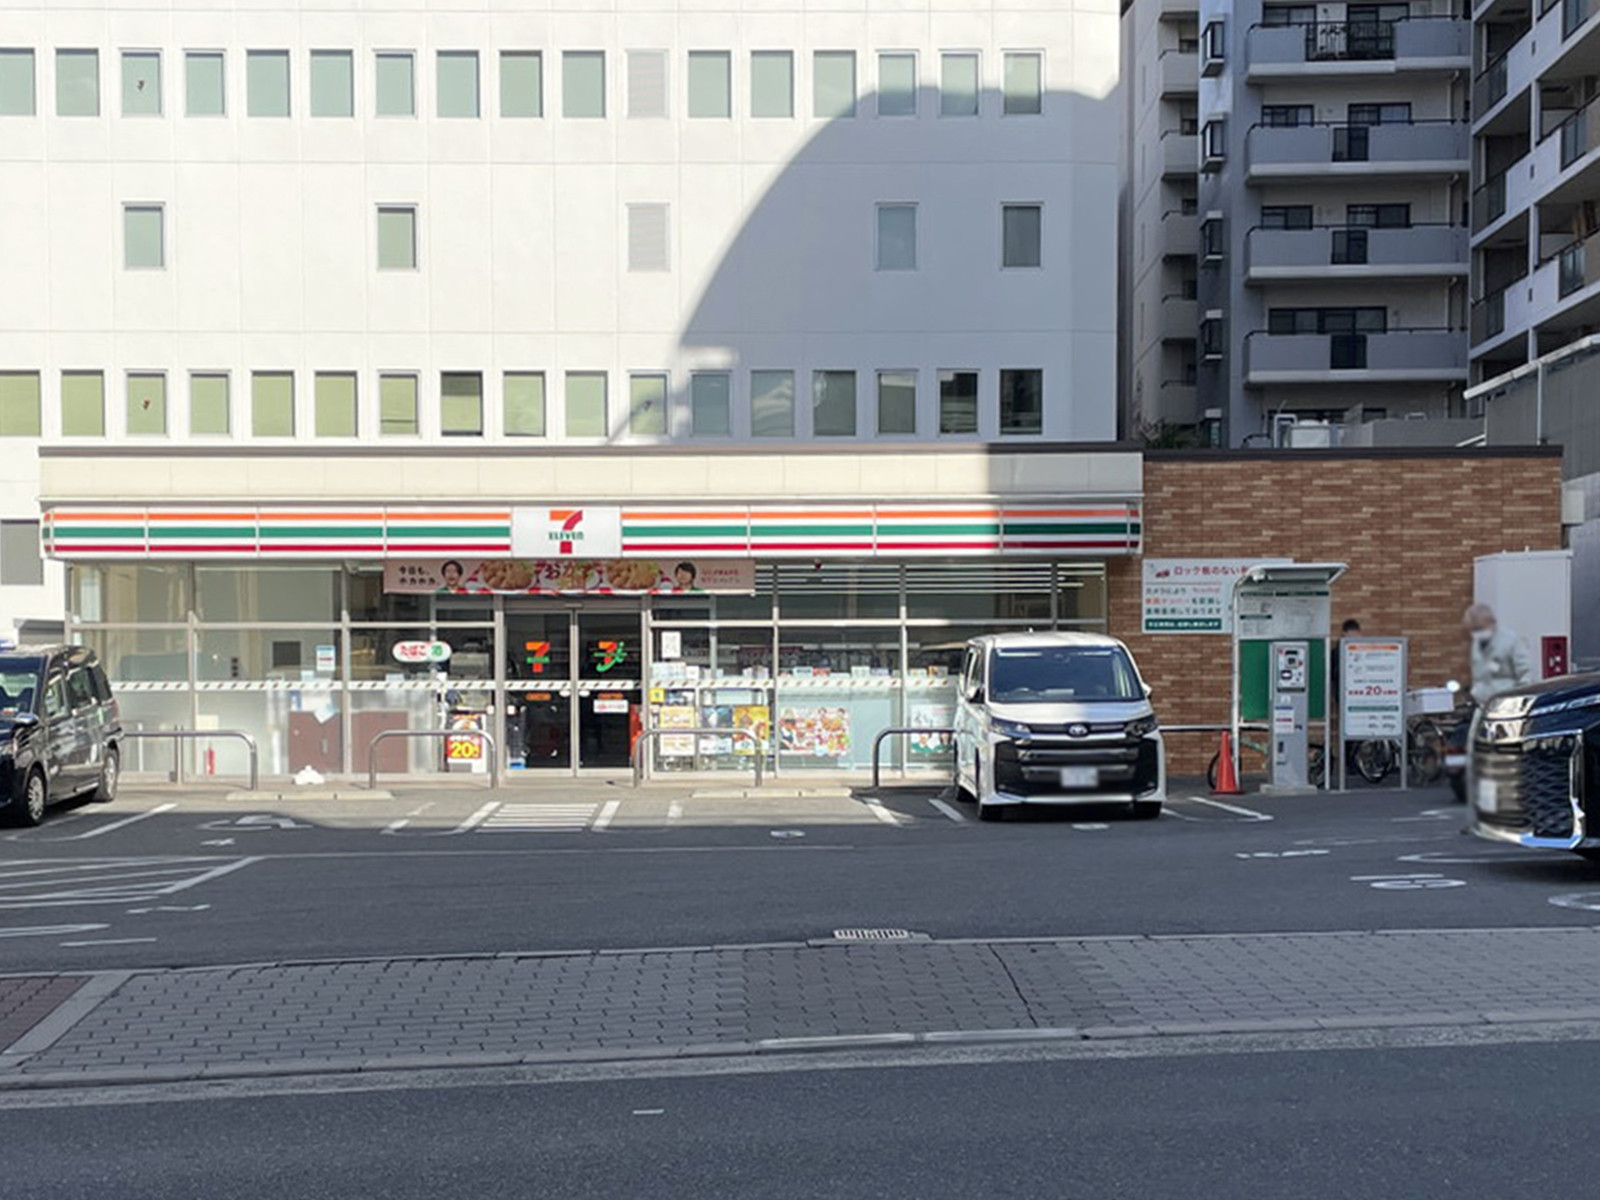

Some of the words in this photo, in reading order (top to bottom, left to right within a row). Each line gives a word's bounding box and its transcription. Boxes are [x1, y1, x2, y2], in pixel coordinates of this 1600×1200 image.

[549, 509, 583, 554] 7
[400, 645, 426, 657] たばこ
